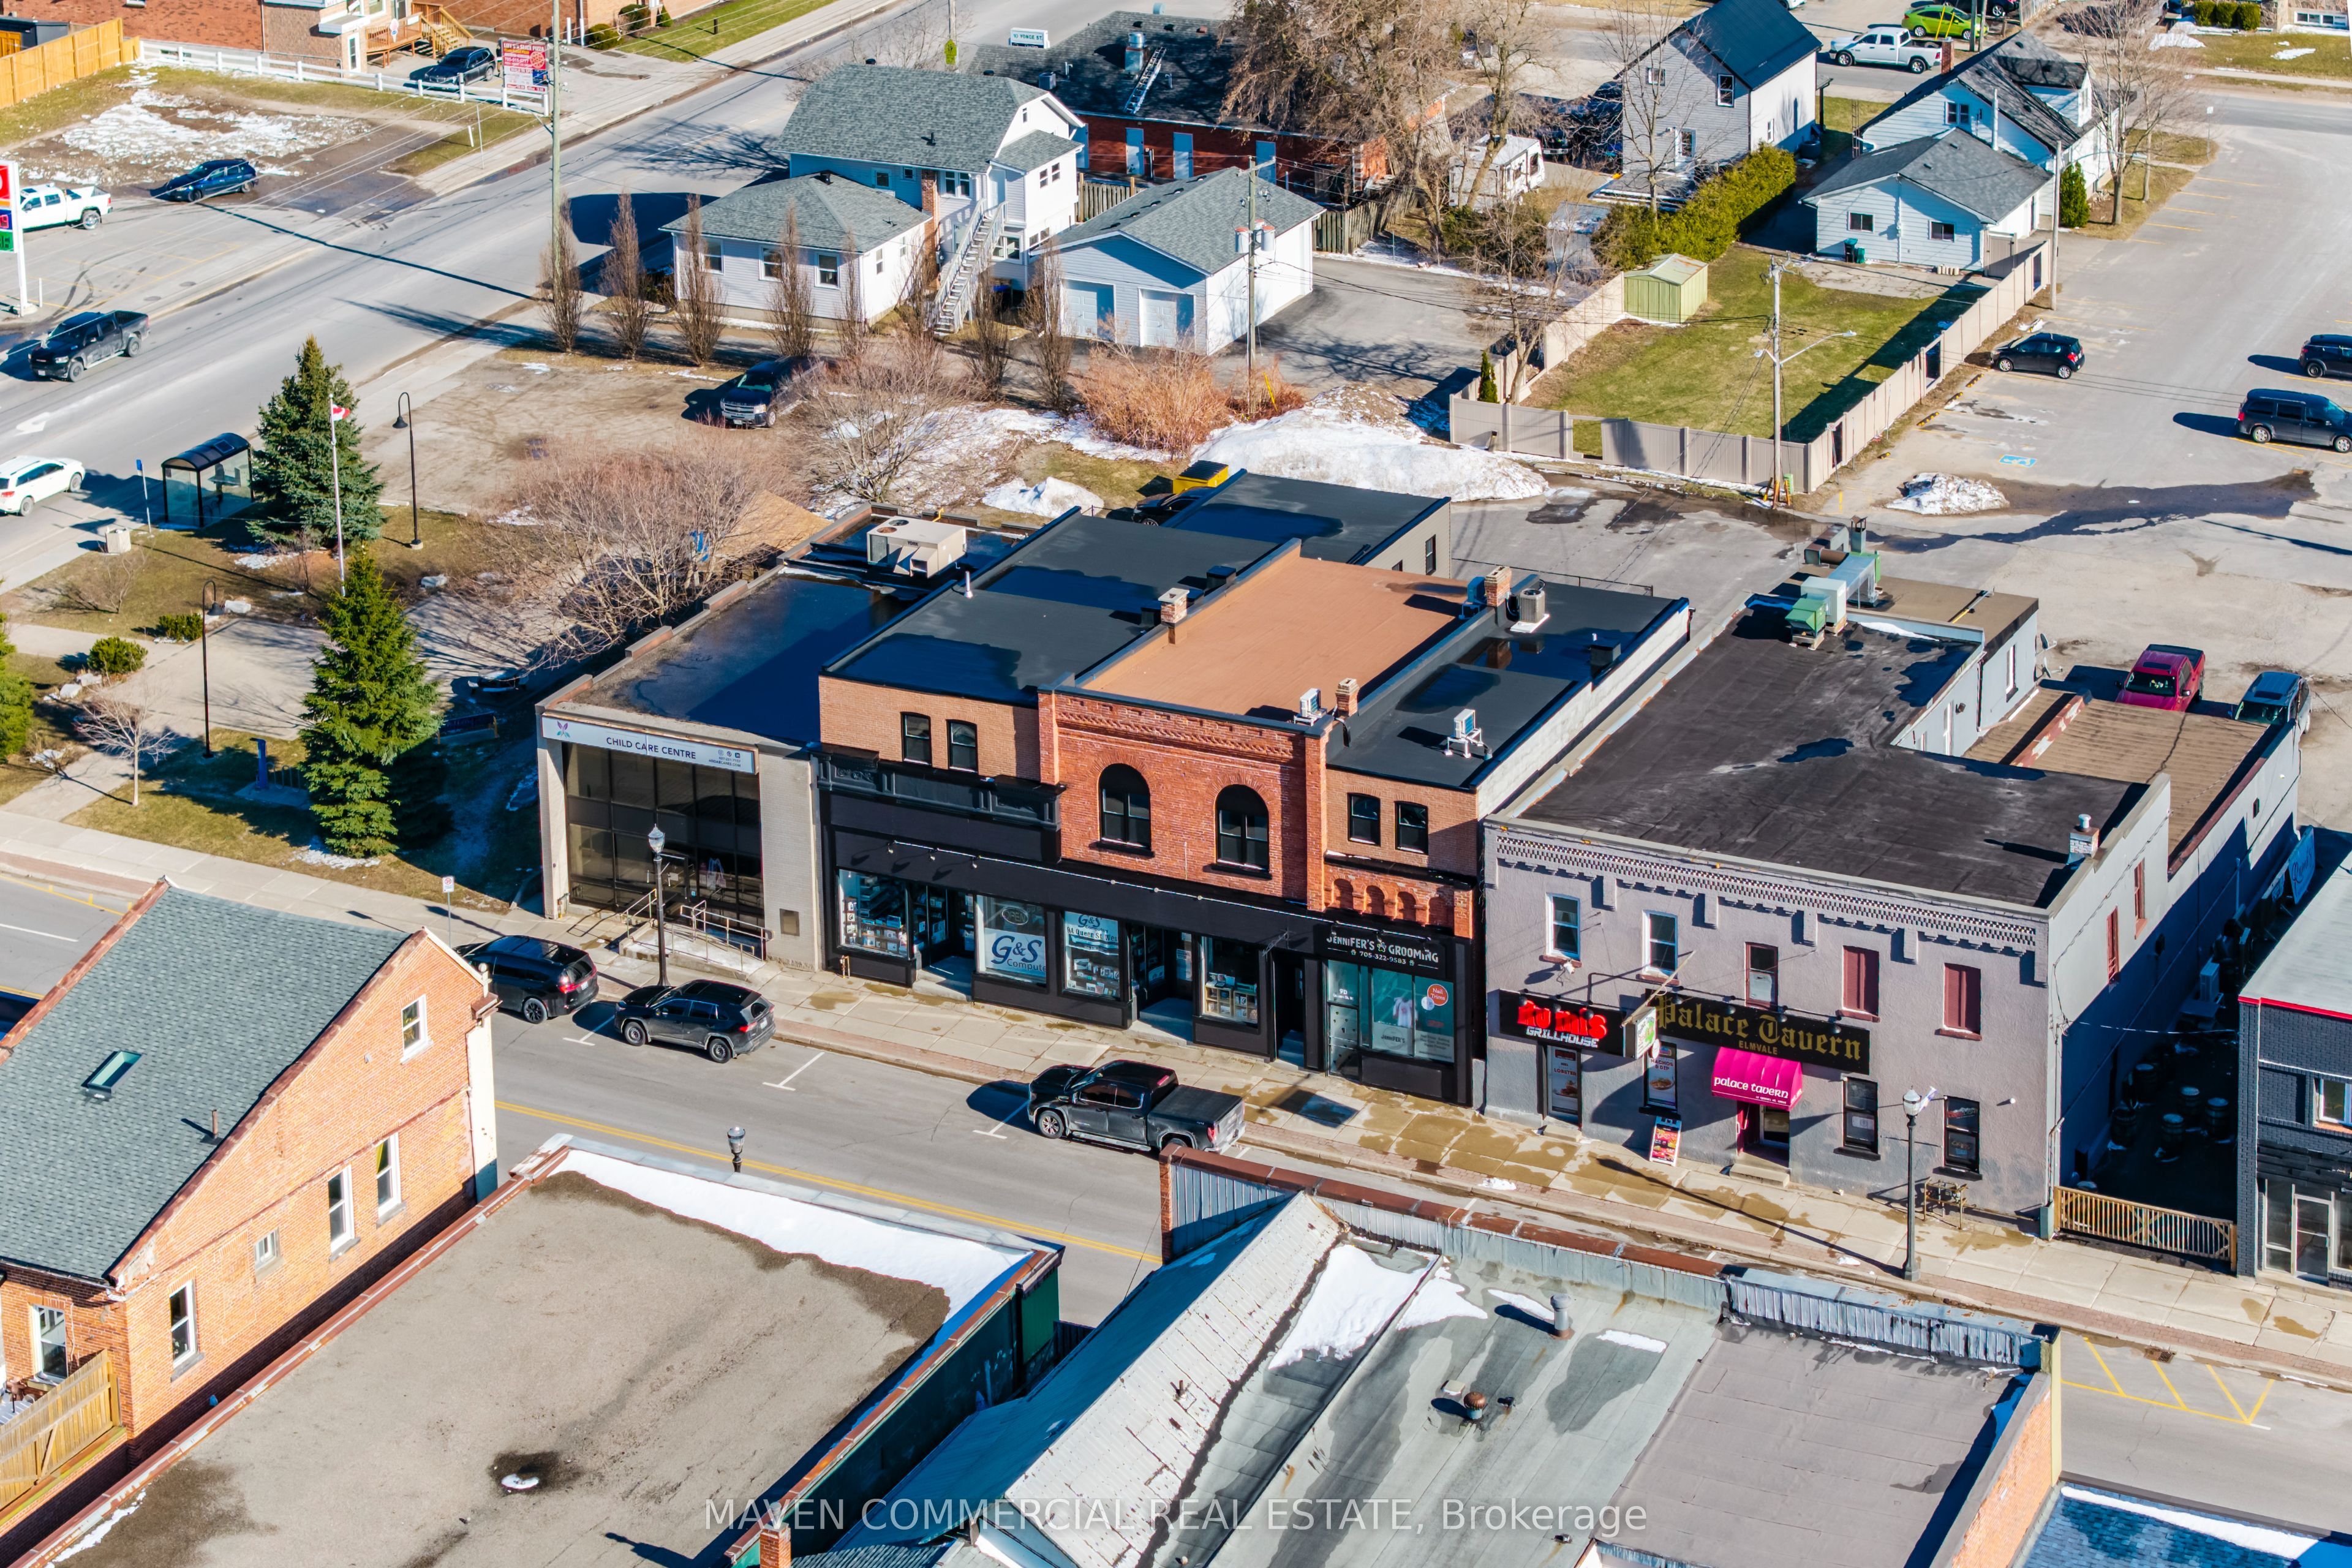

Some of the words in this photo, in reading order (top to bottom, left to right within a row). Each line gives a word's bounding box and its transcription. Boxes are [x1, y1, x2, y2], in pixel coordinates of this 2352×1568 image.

[606, 737, 633, 748] CHILD
[635, 742, 659, 753] CARE
[662, 747, 696, 760] CENTRE
[1076, 929, 1094, 938] Queen
[990, 935, 1042, 965] G&S
[1359, 951, 1406, 965] 705-322-9583
[1526, 1026, 1599, 1049] GRILLHOUSE
[1655, 995, 1749, 1038] Palace
[1758, 1014, 1860, 1061] Tavern
[1738, 1041, 1778, 1055] ELMVALE
[1554, 1068, 1577, 1076] LOBSTER
[1714, 1076, 1749, 1091] palace
[1751, 1083, 1789, 1099] tavern
